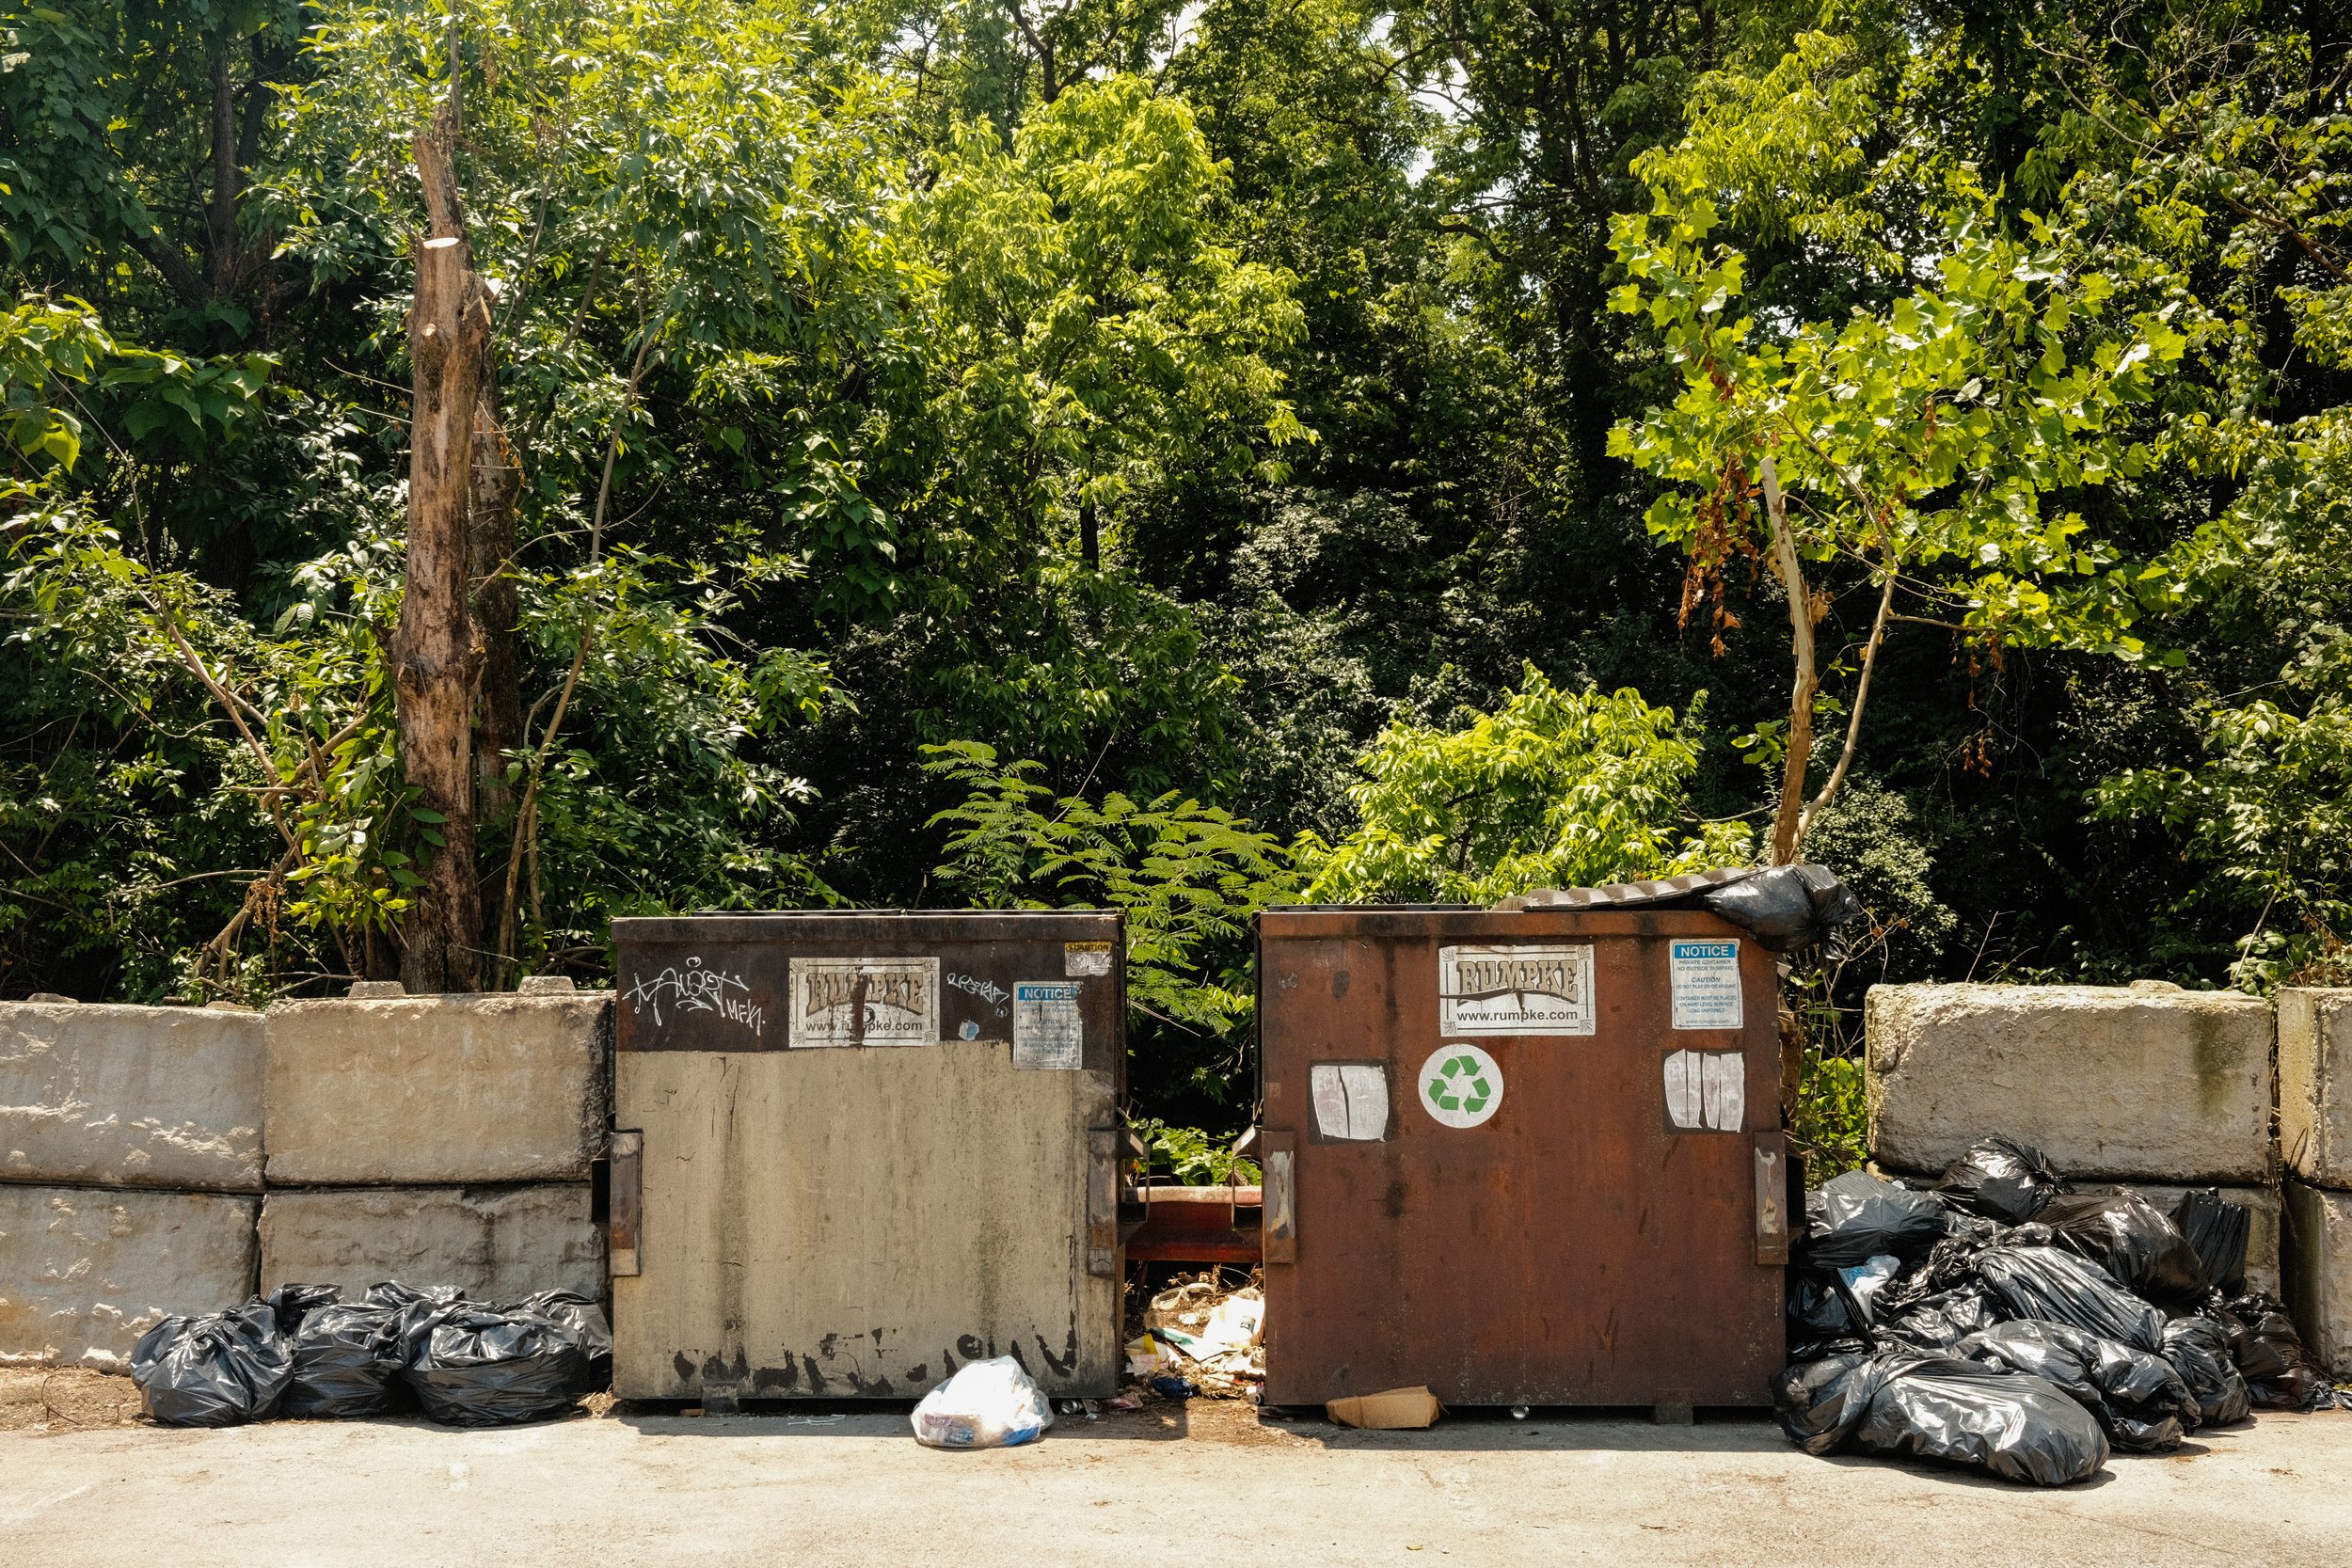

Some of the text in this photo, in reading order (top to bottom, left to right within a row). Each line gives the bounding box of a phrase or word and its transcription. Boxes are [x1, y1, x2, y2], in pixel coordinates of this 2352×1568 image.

[1680, 945, 1729, 958] NOTICE
[1456, 959, 1578, 1007] RUMPKE
[1025, 988, 1072, 999] NOTICE
[1457, 1009, 1578, 1022] www.rumpke.com
